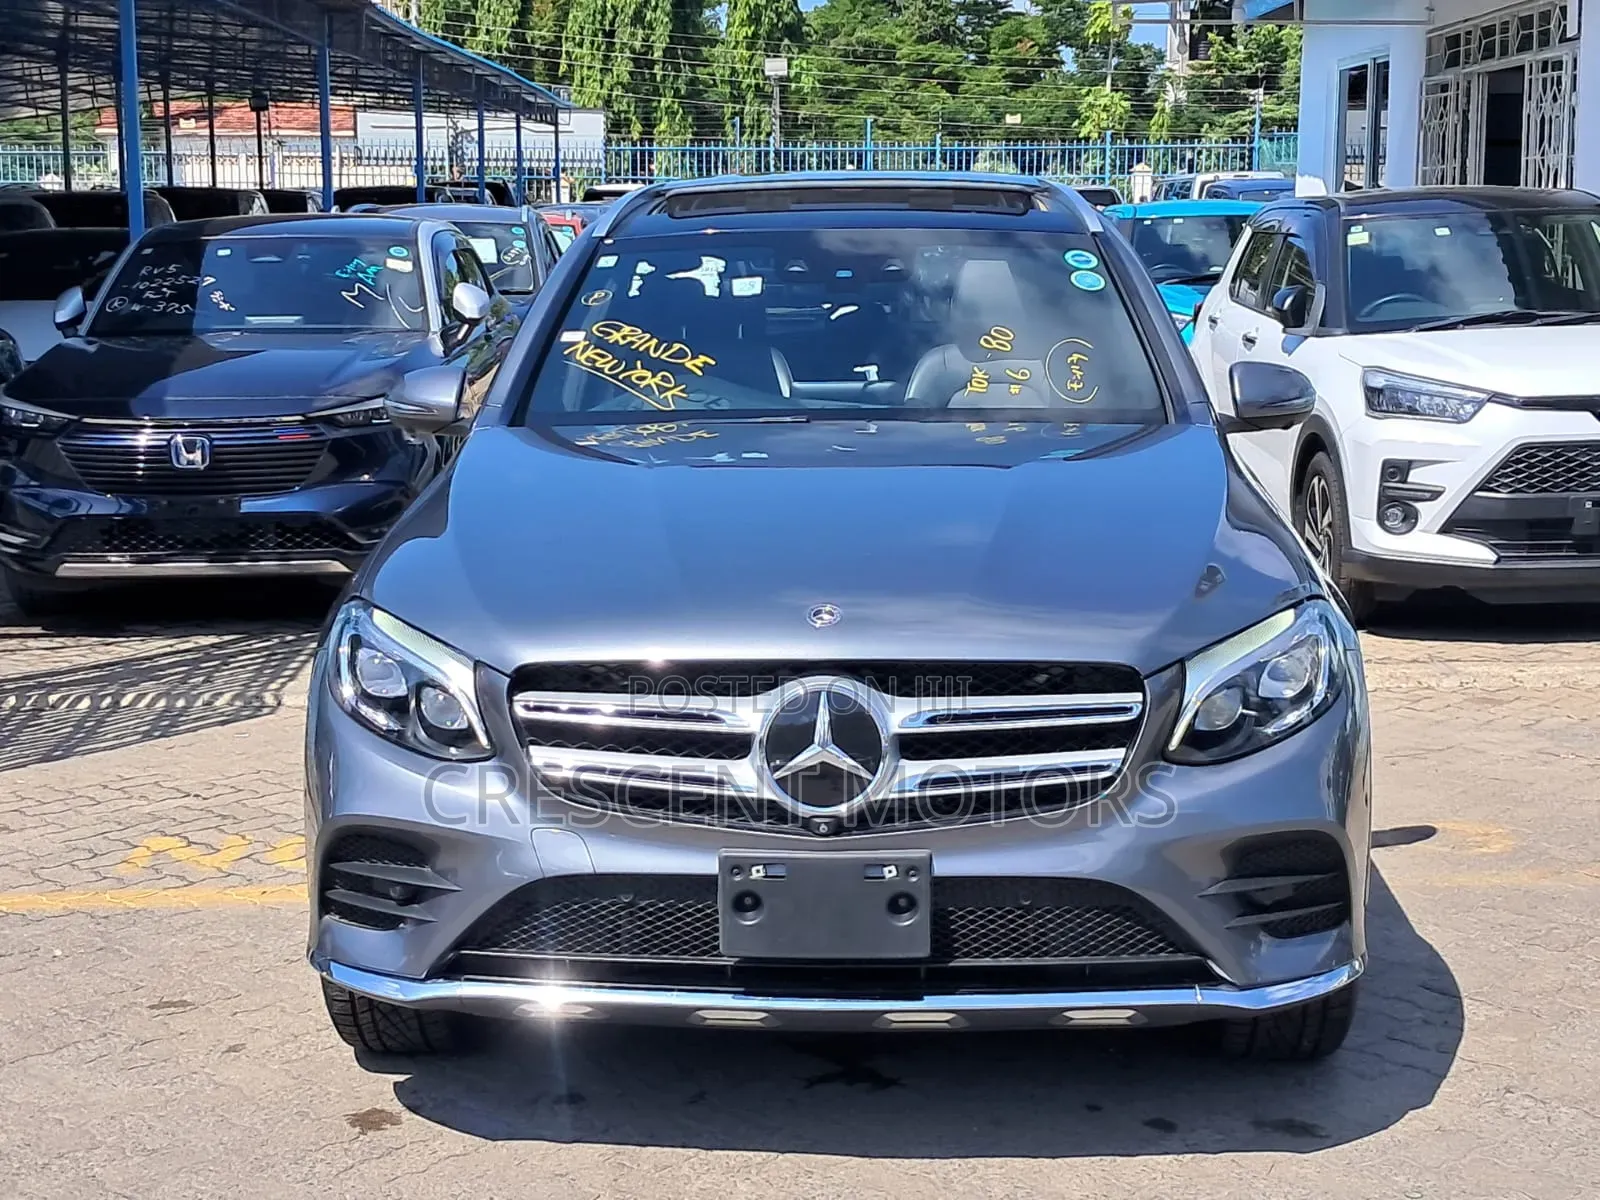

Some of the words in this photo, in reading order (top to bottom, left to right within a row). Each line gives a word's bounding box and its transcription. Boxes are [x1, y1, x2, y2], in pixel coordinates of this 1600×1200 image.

[563, 340, 626, 375] NEW
[618, 360, 690, 410] YORK
[591, 320, 717, 377] GRANDE
